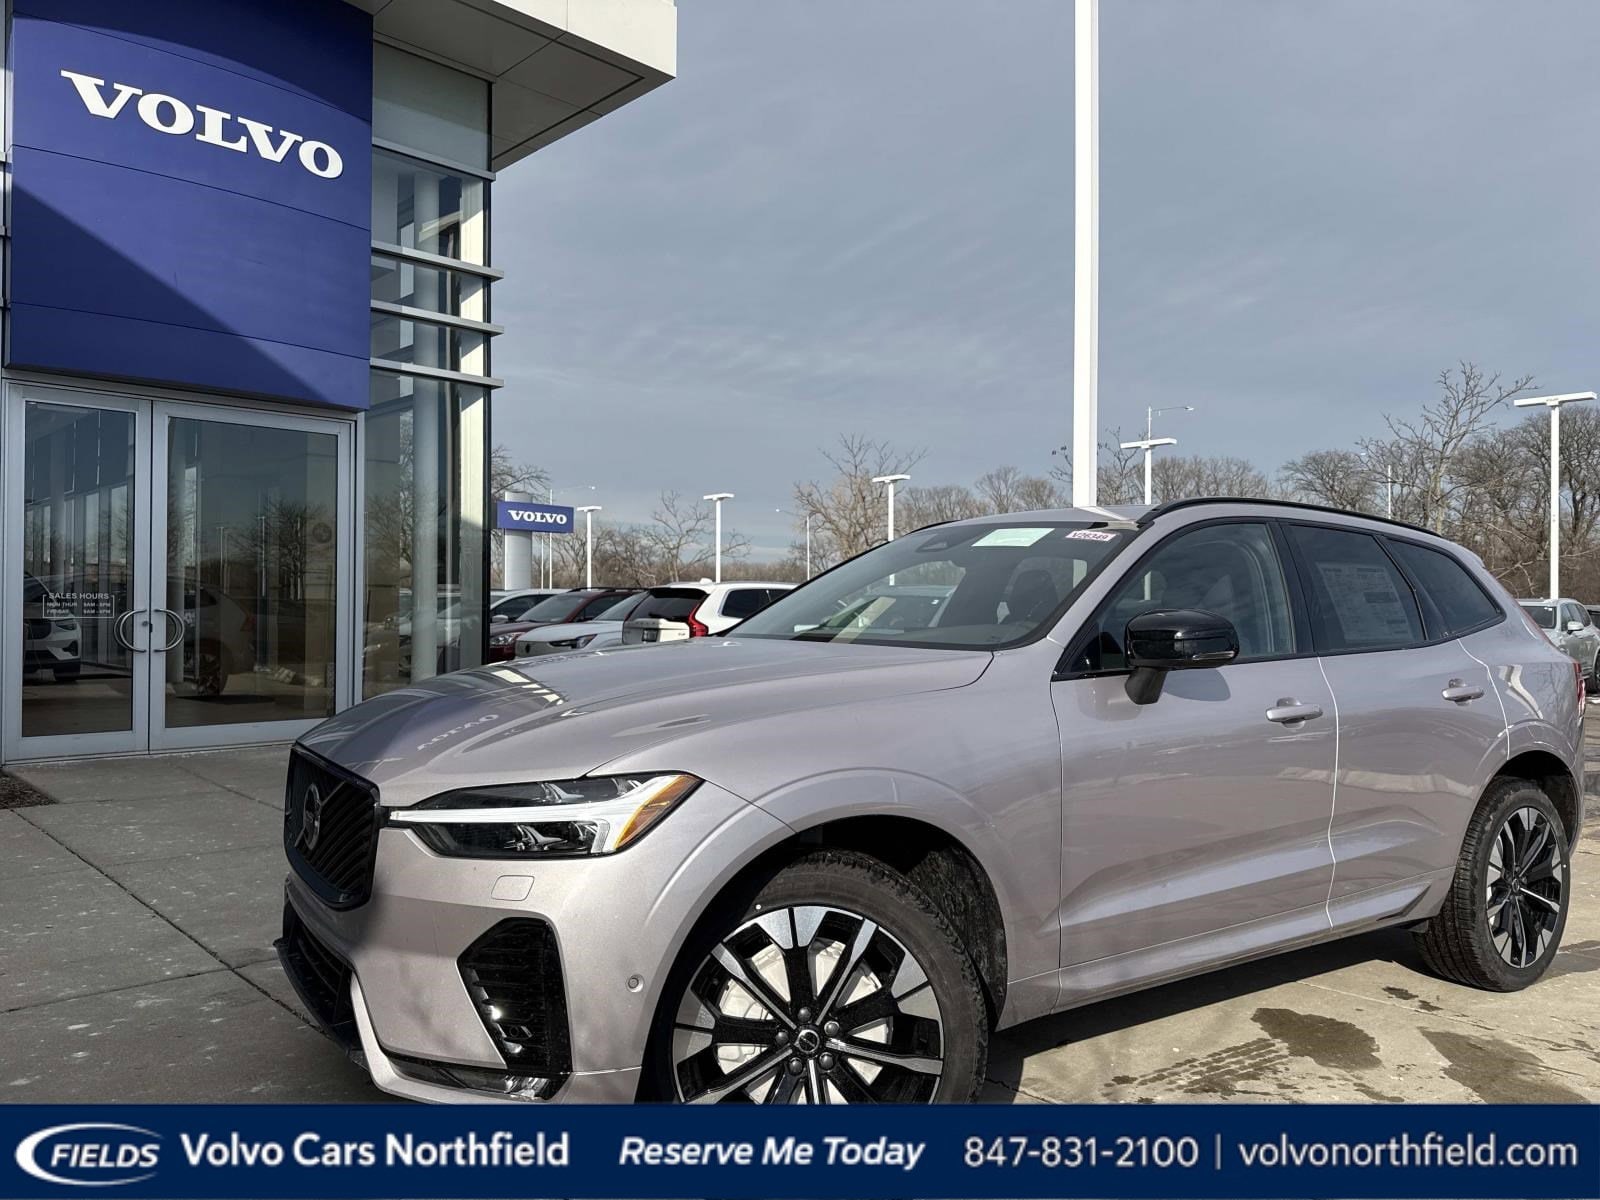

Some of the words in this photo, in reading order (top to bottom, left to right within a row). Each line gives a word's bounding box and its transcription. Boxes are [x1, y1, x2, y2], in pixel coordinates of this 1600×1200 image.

[61, 70, 343, 179] VOLVO
[508, 510, 567, 525] VOLVO
[79, 592, 110, 600] HOURS
